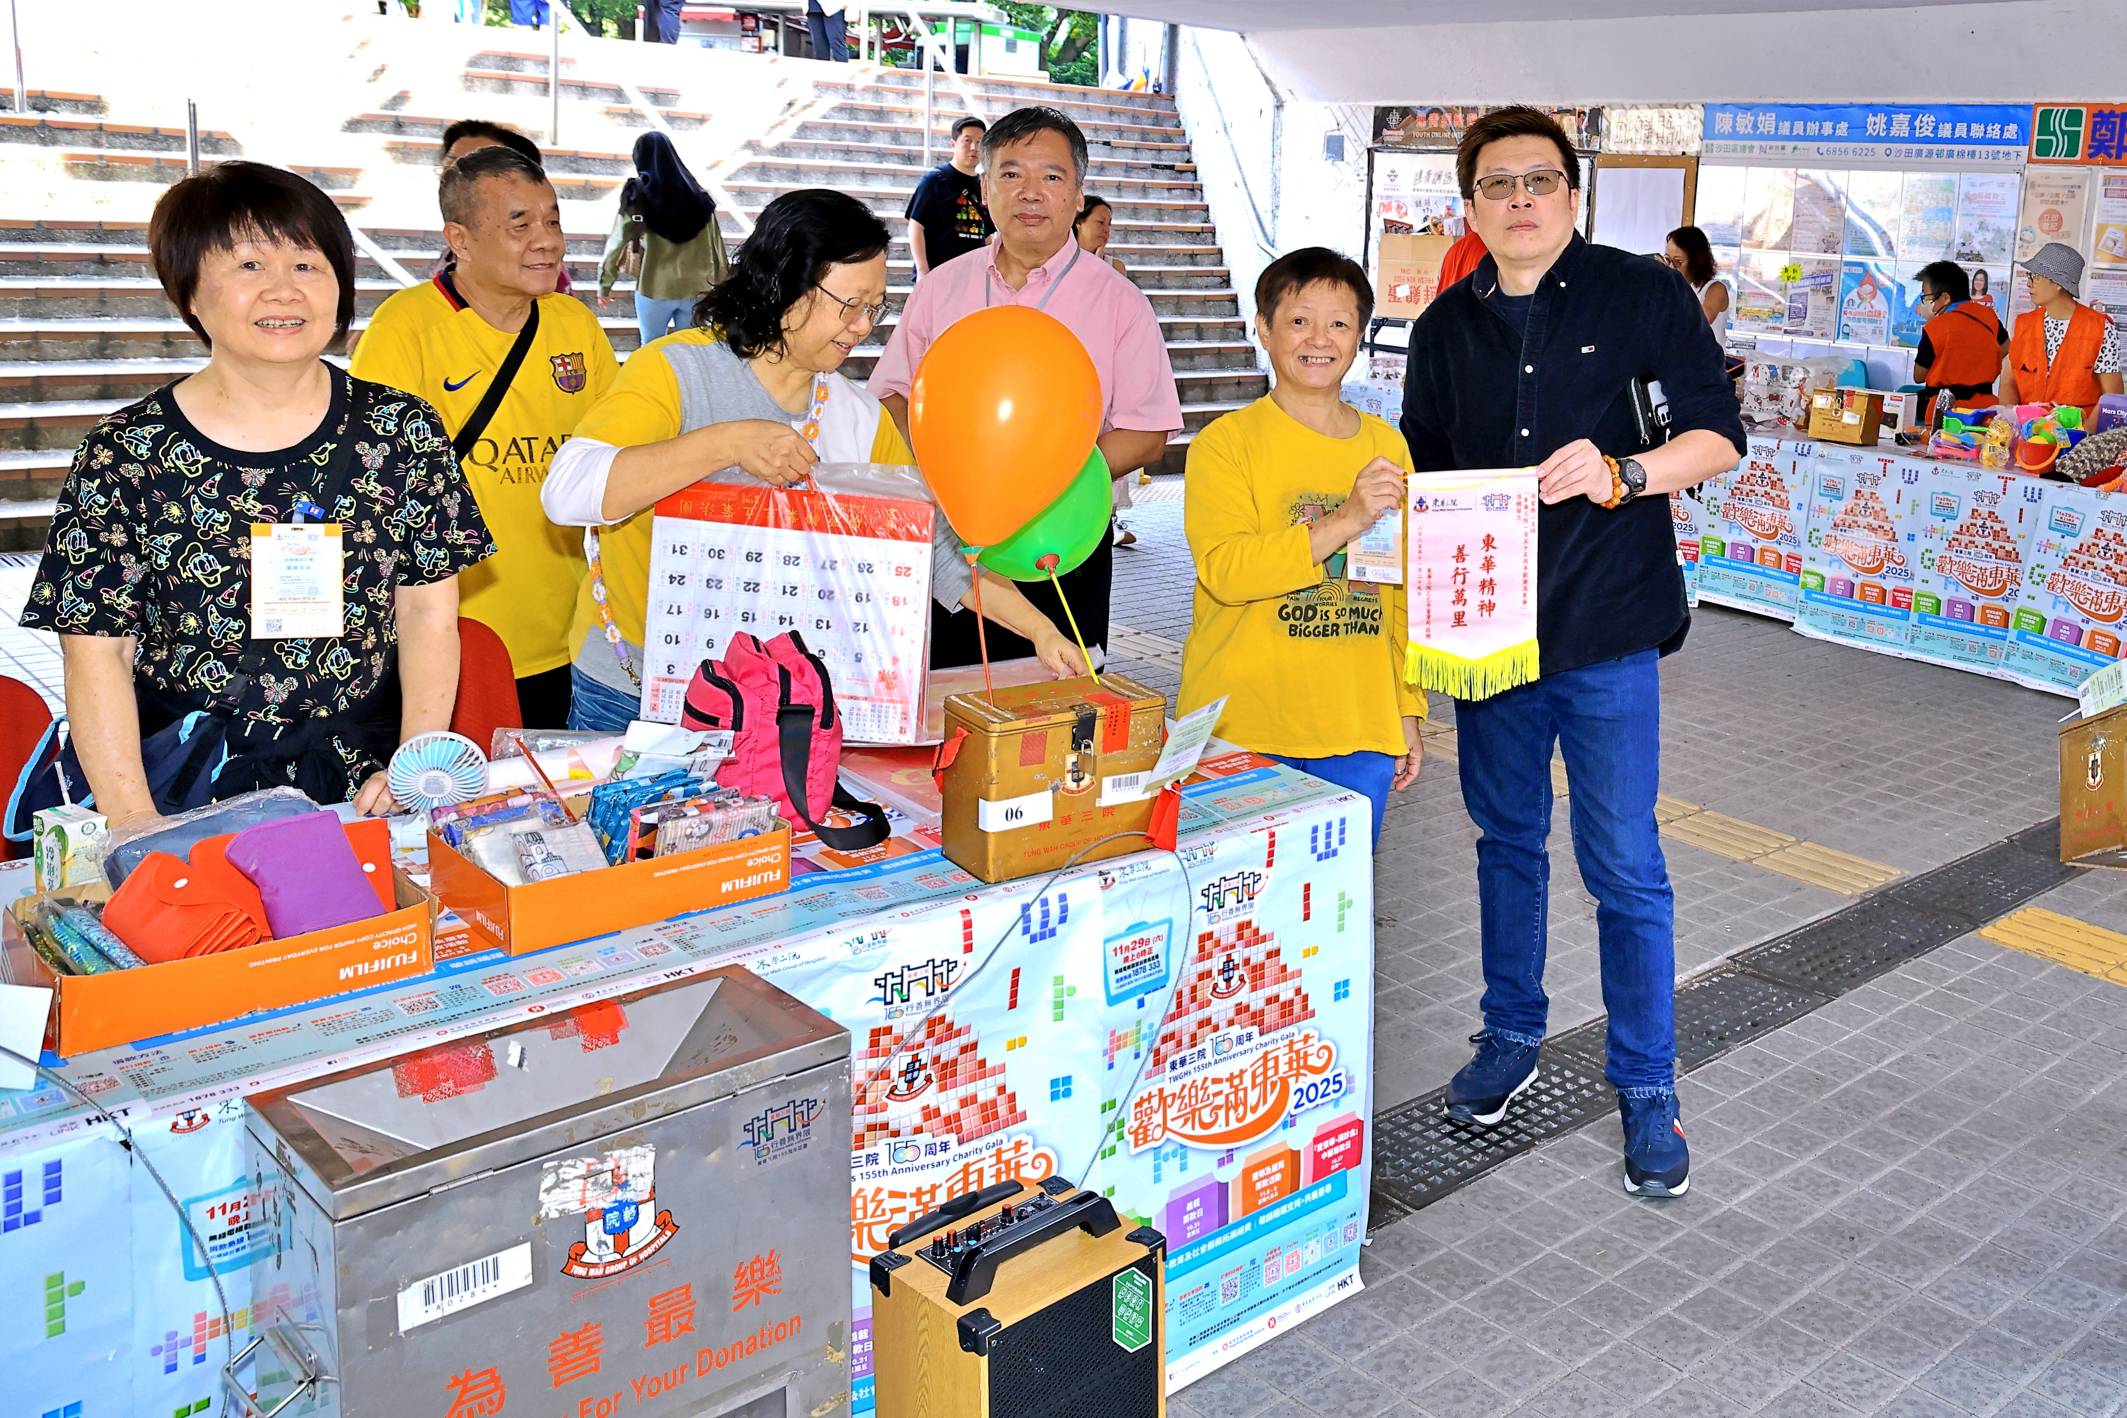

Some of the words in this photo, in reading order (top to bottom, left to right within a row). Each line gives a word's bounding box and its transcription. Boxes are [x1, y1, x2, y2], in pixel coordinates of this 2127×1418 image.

[1714, 112, 1849, 137] 陳敏娟議員辦事處
[1866, 113, 2018, 140] 姚嘉俊議員聯絡處
[1826, 147, 1849, 156] 6856
[1852, 147, 1876, 157] 6225
[500, 467, 548, 485] AIRW
[1780, 533, 1798, 544] 2025
[671, 543, 688, 555] 31
[708, 548, 725, 559] 30
[745, 552, 763, 563] 29
[783, 555, 800, 566] 28
[820, 559, 838, 570] 27
[857, 562, 874, 573] 26
[895, 565, 912, 577] 25
[1477, 533, 1498, 618] 東華精神
[1885, 566, 1909, 577] 2025
[668, 574, 686, 585] 24
[706, 578, 723, 589] 23
[1451, 544, 1471, 628] 善行萬里
[743, 581, 760, 593] 22
[782, 585, 798, 596] 21
[818, 589, 835, 600] 20
[855, 592, 871, 603] 19
[892, 595, 908, 606] 18
[2046, 571, 2127, 624] 歡樂滿東
[666, 604, 683, 615] 17
[703, 608, 720, 620] 16
[1278, 604, 1318, 622] GOD
[741, 611, 757, 623] 15
[778, 615, 795, 626] 14
[815, 618, 832, 630] 13
[852, 622, 868, 633] 12
[1343, 621, 1380, 636] THAN
[664, 633, 681, 645] 10
[706, 637, 715, 649] 9
[854, 652, 863, 663] 5
[667, 664, 676, 675] 3
[1005, 806, 1023, 822] 06
[1024, 849, 1041, 858] TUNG
[1043, 845, 1059, 855] WAH
[746, 852, 782, 868] Choice
[720, 869, 781, 893] FUJIFILM
[475, 910, 504, 941] FUJIFILM
[333, 939, 355, 948] PAPER
[356, 934, 373, 942] COPY
[372, 932, 417, 951] Choice
[1112, 937, 1151, 956] 11月29日
[1152, 933, 1164, 945] (六)
[282, 947, 317, 960] EVERYDAY
[248, 955, 281, 968] PRINTING
[338, 951, 418, 980] FUJIFILM
[1132, 964, 1147, 976] 1878
[1148, 960, 1160, 972] 333
[663, 966, 695, 980] HKT
[1168, 1071, 1192, 1084] TWGHs
[1192, 1063, 1213, 1077] 155th
[1213, 1047, 1254, 1066] Anniversary
[1255, 1037, 1280, 1054] Charity
[1280, 1031, 1296, 1043] Gala
[1169, 1048, 1207, 1072] 東華三院
[1235, 1031, 1254, 1047] 周年
[189, 1090, 217, 1102] 1878
[219, 1085, 240, 1094] 333
[1128, 1033, 1333, 1149] 歡樂滿東華
[1294, 1073, 1343, 1110] 2025
[85, 1107, 132, 1126] HKT
[218, 1116, 236, 1126] Tung
[851, 1152, 880, 1170] 三院
[924, 1139, 951, 1157] 周年
[860, 1165, 889, 1181] 155th
[891, 1154, 951, 1179] Anniversary
[952, 1142, 984, 1164] Charity
[985, 1137, 1004, 1151] Gala
[851, 1140, 1055, 1250] 樂滿東華
[1187, 1221, 1201, 1231] 10.31
[570, 1265, 588, 1277] TUNG
[588, 1266, 605, 1277] WAH
[605, 1260, 628, 1274] GROUP
[629, 1255, 638, 1266] OF
[639, 1230, 673, 1261] HOSPITALS
[1337, 1273, 1354, 1292] HKT
[445, 1248, 784, 1418] 為善最樂
[853, 1341, 873, 1355] 款日
[578, 1391, 624, 1418] For
[629, 1362, 689, 1405] Your
[695, 1314, 802, 1378] Donation
[852, 1356, 868, 1365] 0.31
